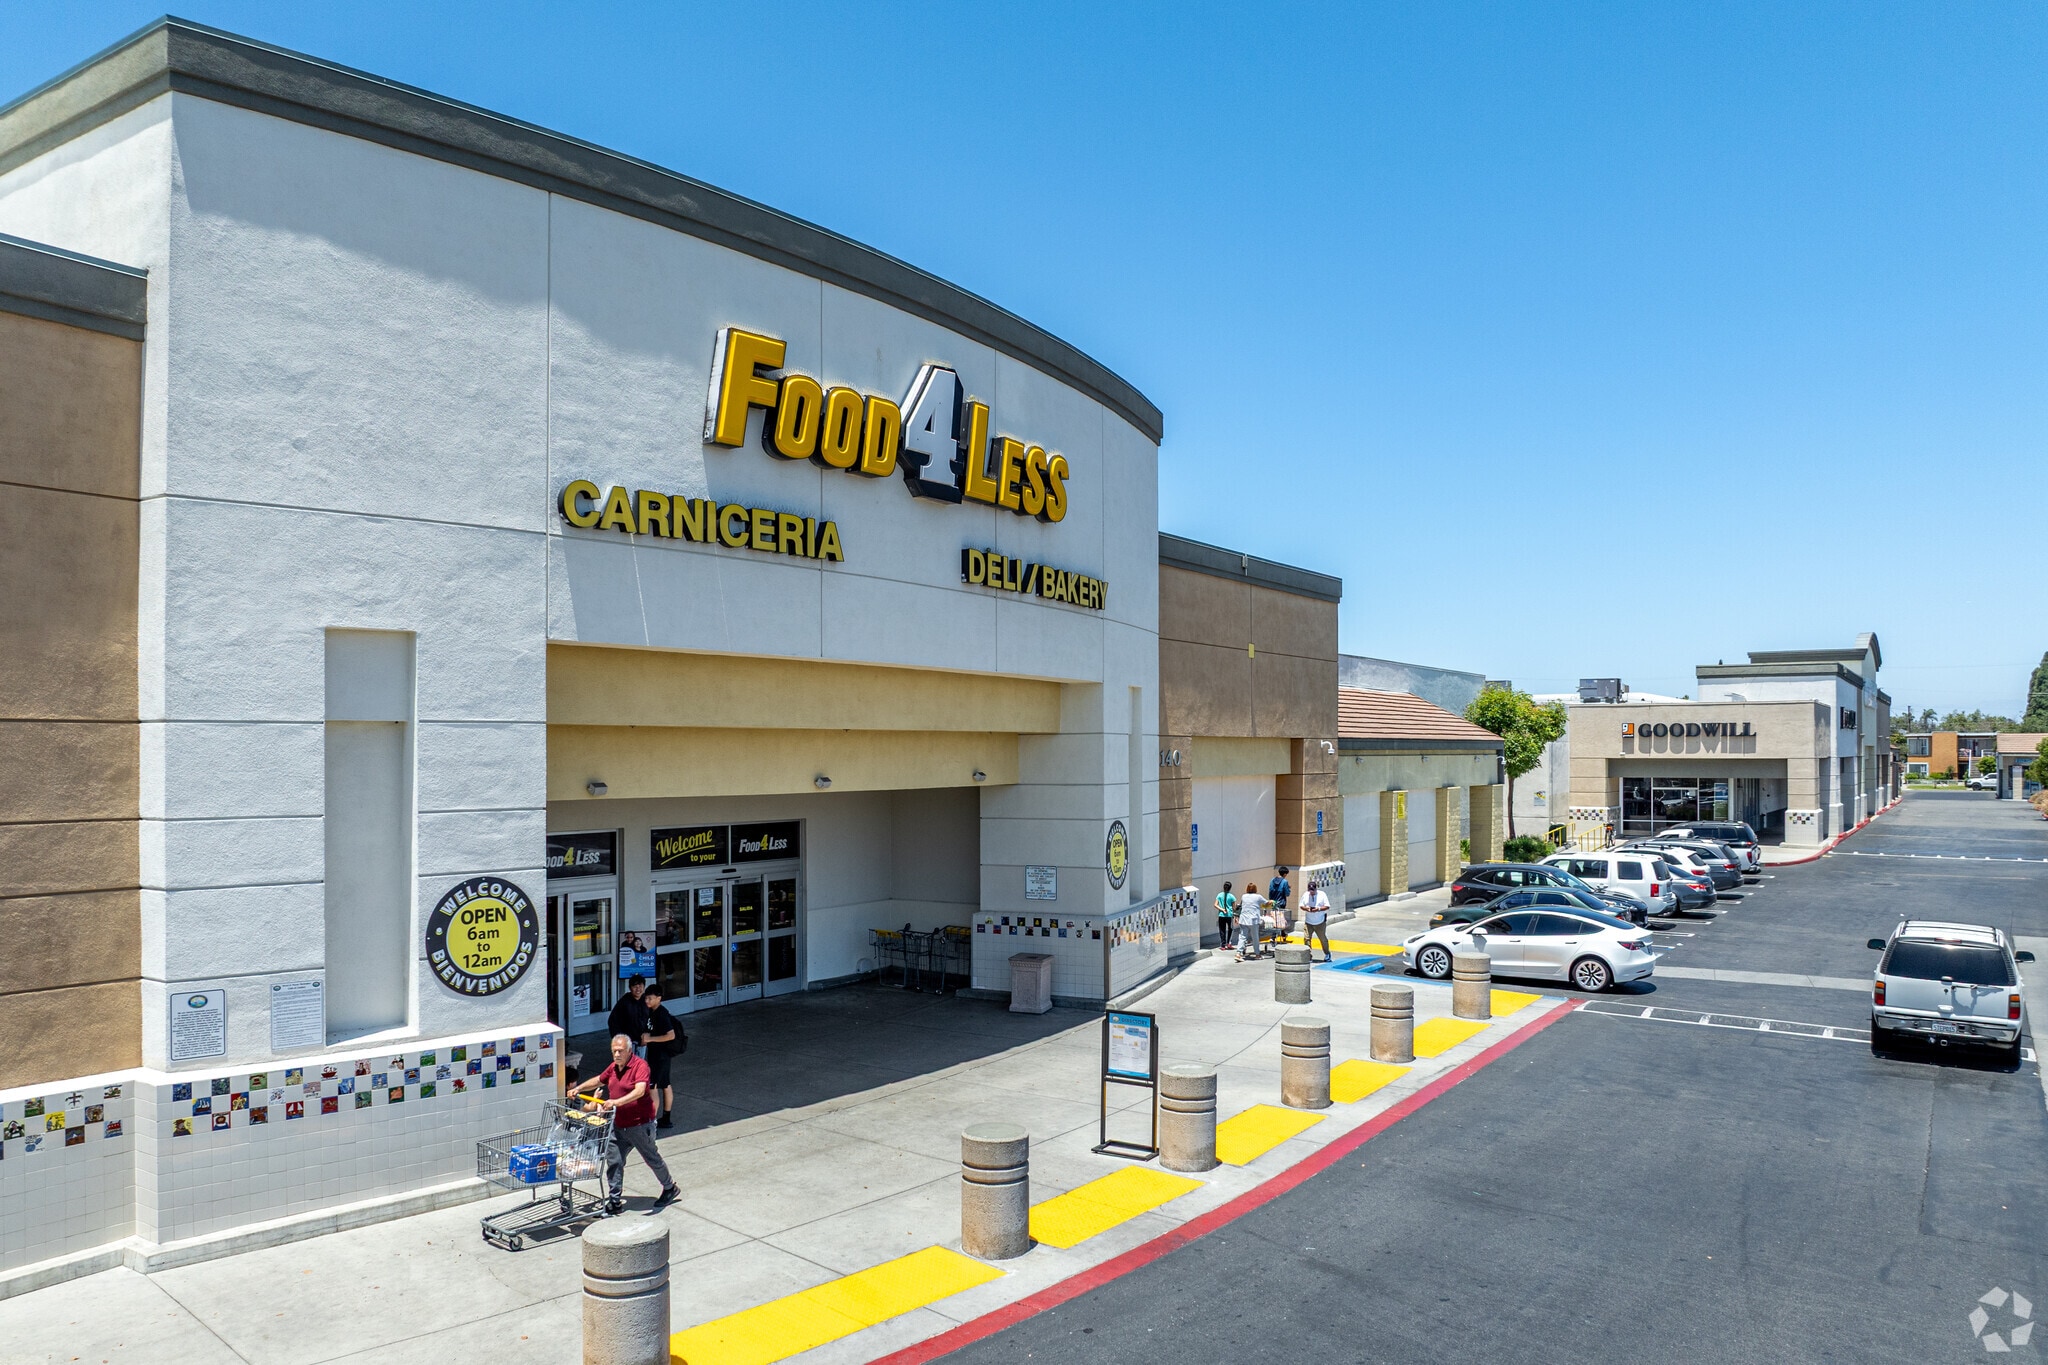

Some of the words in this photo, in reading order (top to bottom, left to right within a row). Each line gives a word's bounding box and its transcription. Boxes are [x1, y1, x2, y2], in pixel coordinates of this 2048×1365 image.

[898, 364, 964, 504] 4
[558, 480, 844, 562] CARNICERIA
[1638, 722, 1757, 738] GOODWILL
[1160, 749, 1181, 767] 140
[656, 830, 713, 858] Welcome
[760, 834, 769, 850] 4
[546, 855, 564, 868] OOD
[563, 847, 574, 866] 4
[690, 853, 699, 862] to
[699, 853, 716, 863] your
[439, 882, 528, 917] WELCOME
[460, 907, 507, 925] OPEN
[467, 926, 500, 941] 6am
[477, 942, 491, 953] to
[431, 941, 533, 993] BIENVENIDOS
[463, 954, 502, 969] 12am
